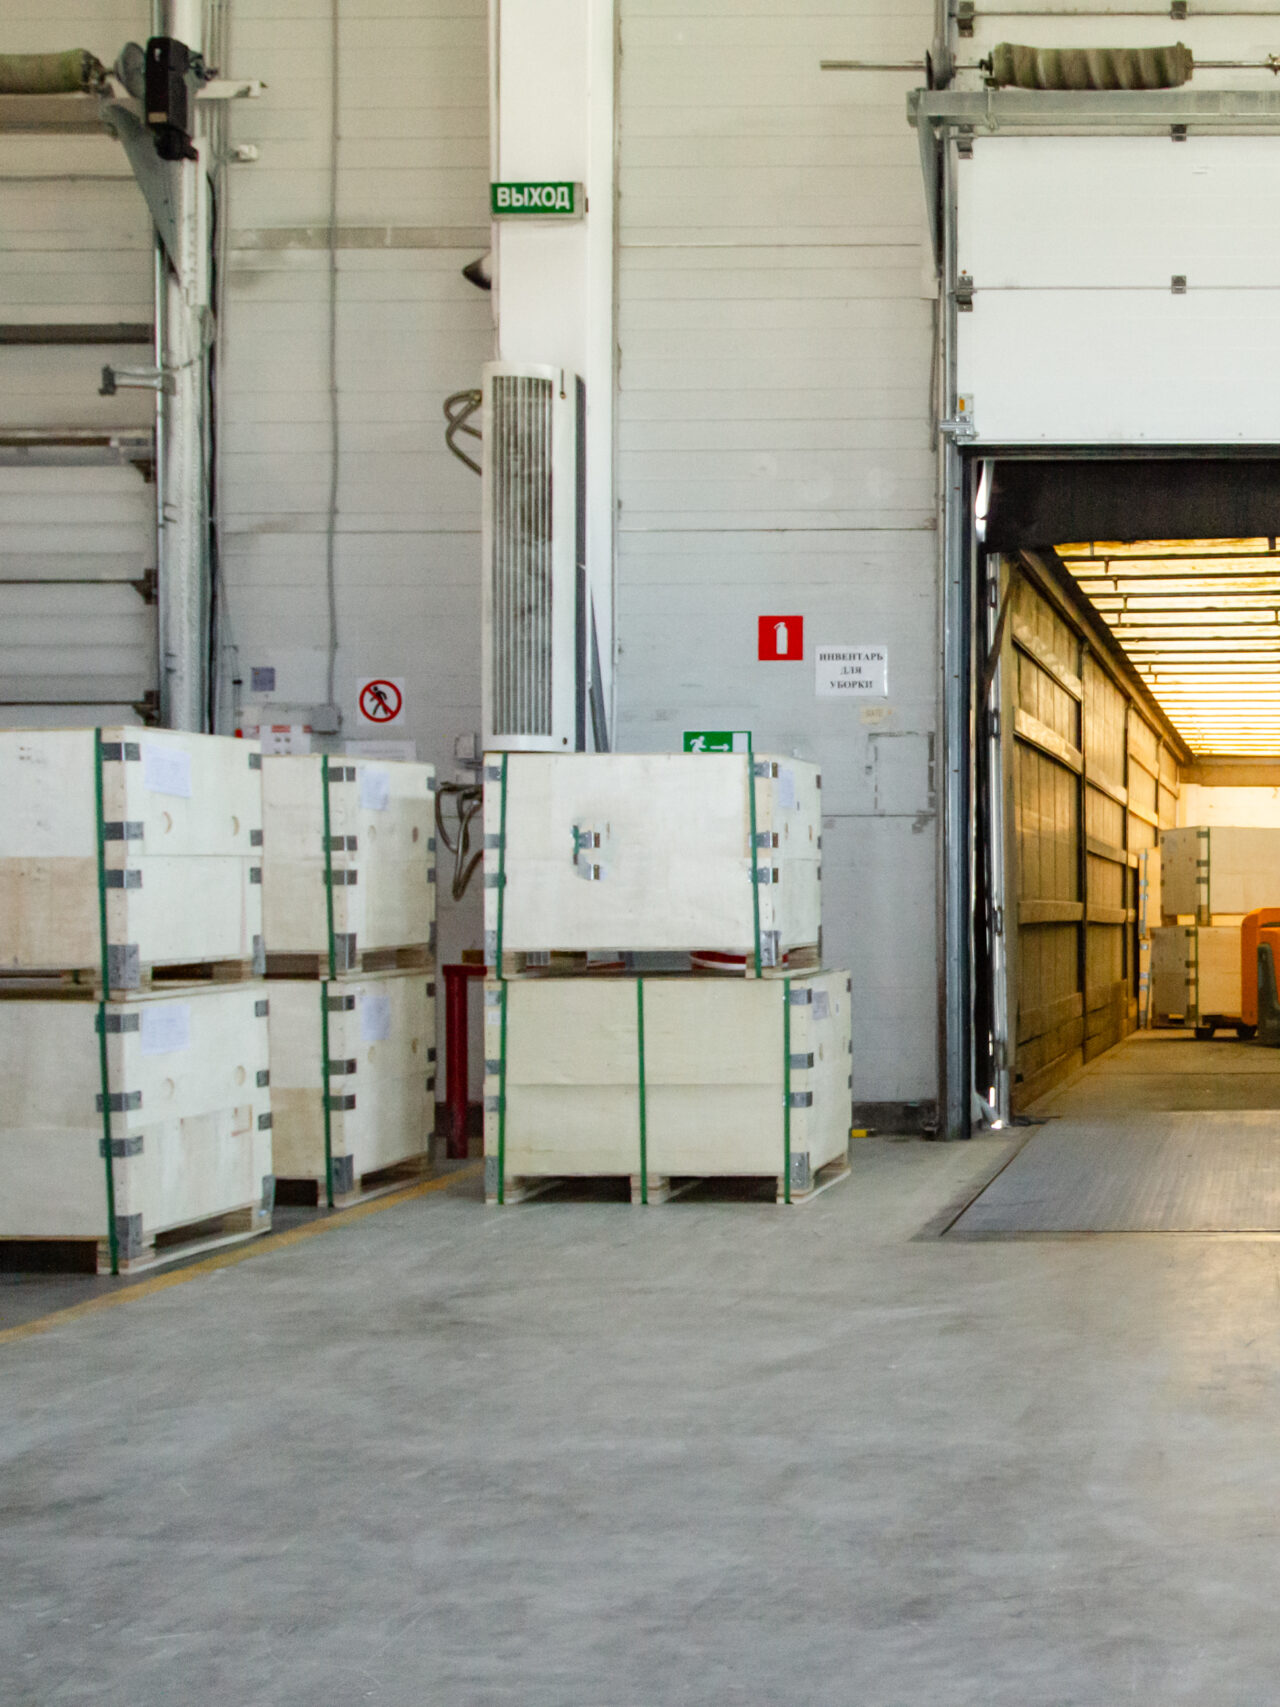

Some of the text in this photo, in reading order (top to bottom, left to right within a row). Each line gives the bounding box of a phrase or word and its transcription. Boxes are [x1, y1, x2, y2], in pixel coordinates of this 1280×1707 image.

[497, 186, 570, 210] ВЫХОД
[819, 652, 884, 661] ИНВЕНТАРЬ
[840, 666, 862, 675] ДЛЯ
[830, 680, 873, 689] УБОРКИ
